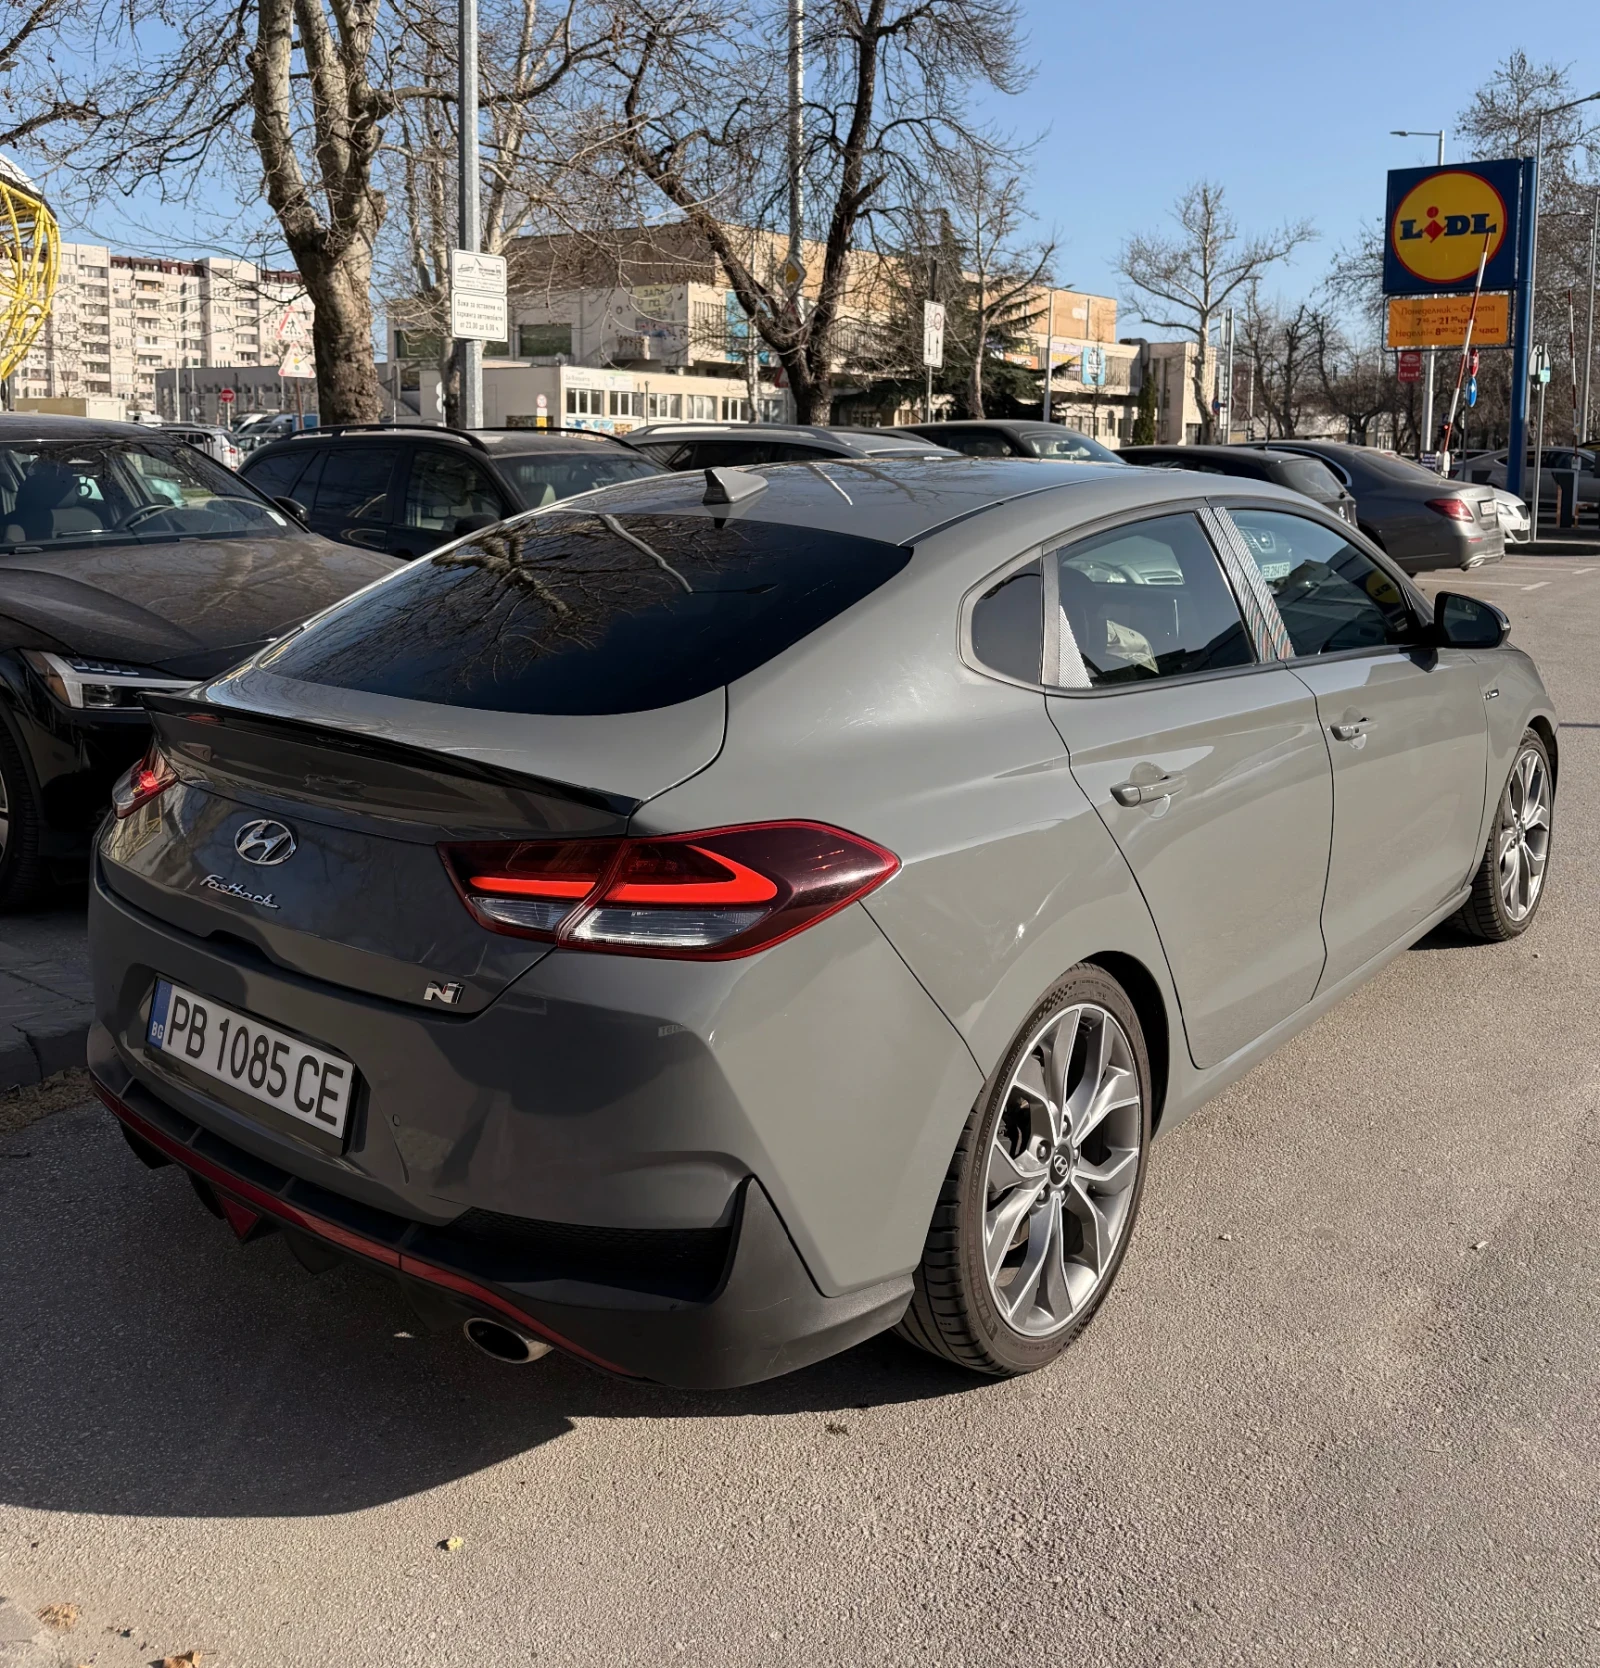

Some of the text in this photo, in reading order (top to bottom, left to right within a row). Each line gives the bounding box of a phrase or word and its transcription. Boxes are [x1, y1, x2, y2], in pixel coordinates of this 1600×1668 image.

[1401, 305, 1452, 317] Понеделник
[200, 873, 281, 910] Fastback
[151, 1020, 164, 1040] BG
[167, 994, 344, 1127] PB 1085 CE
